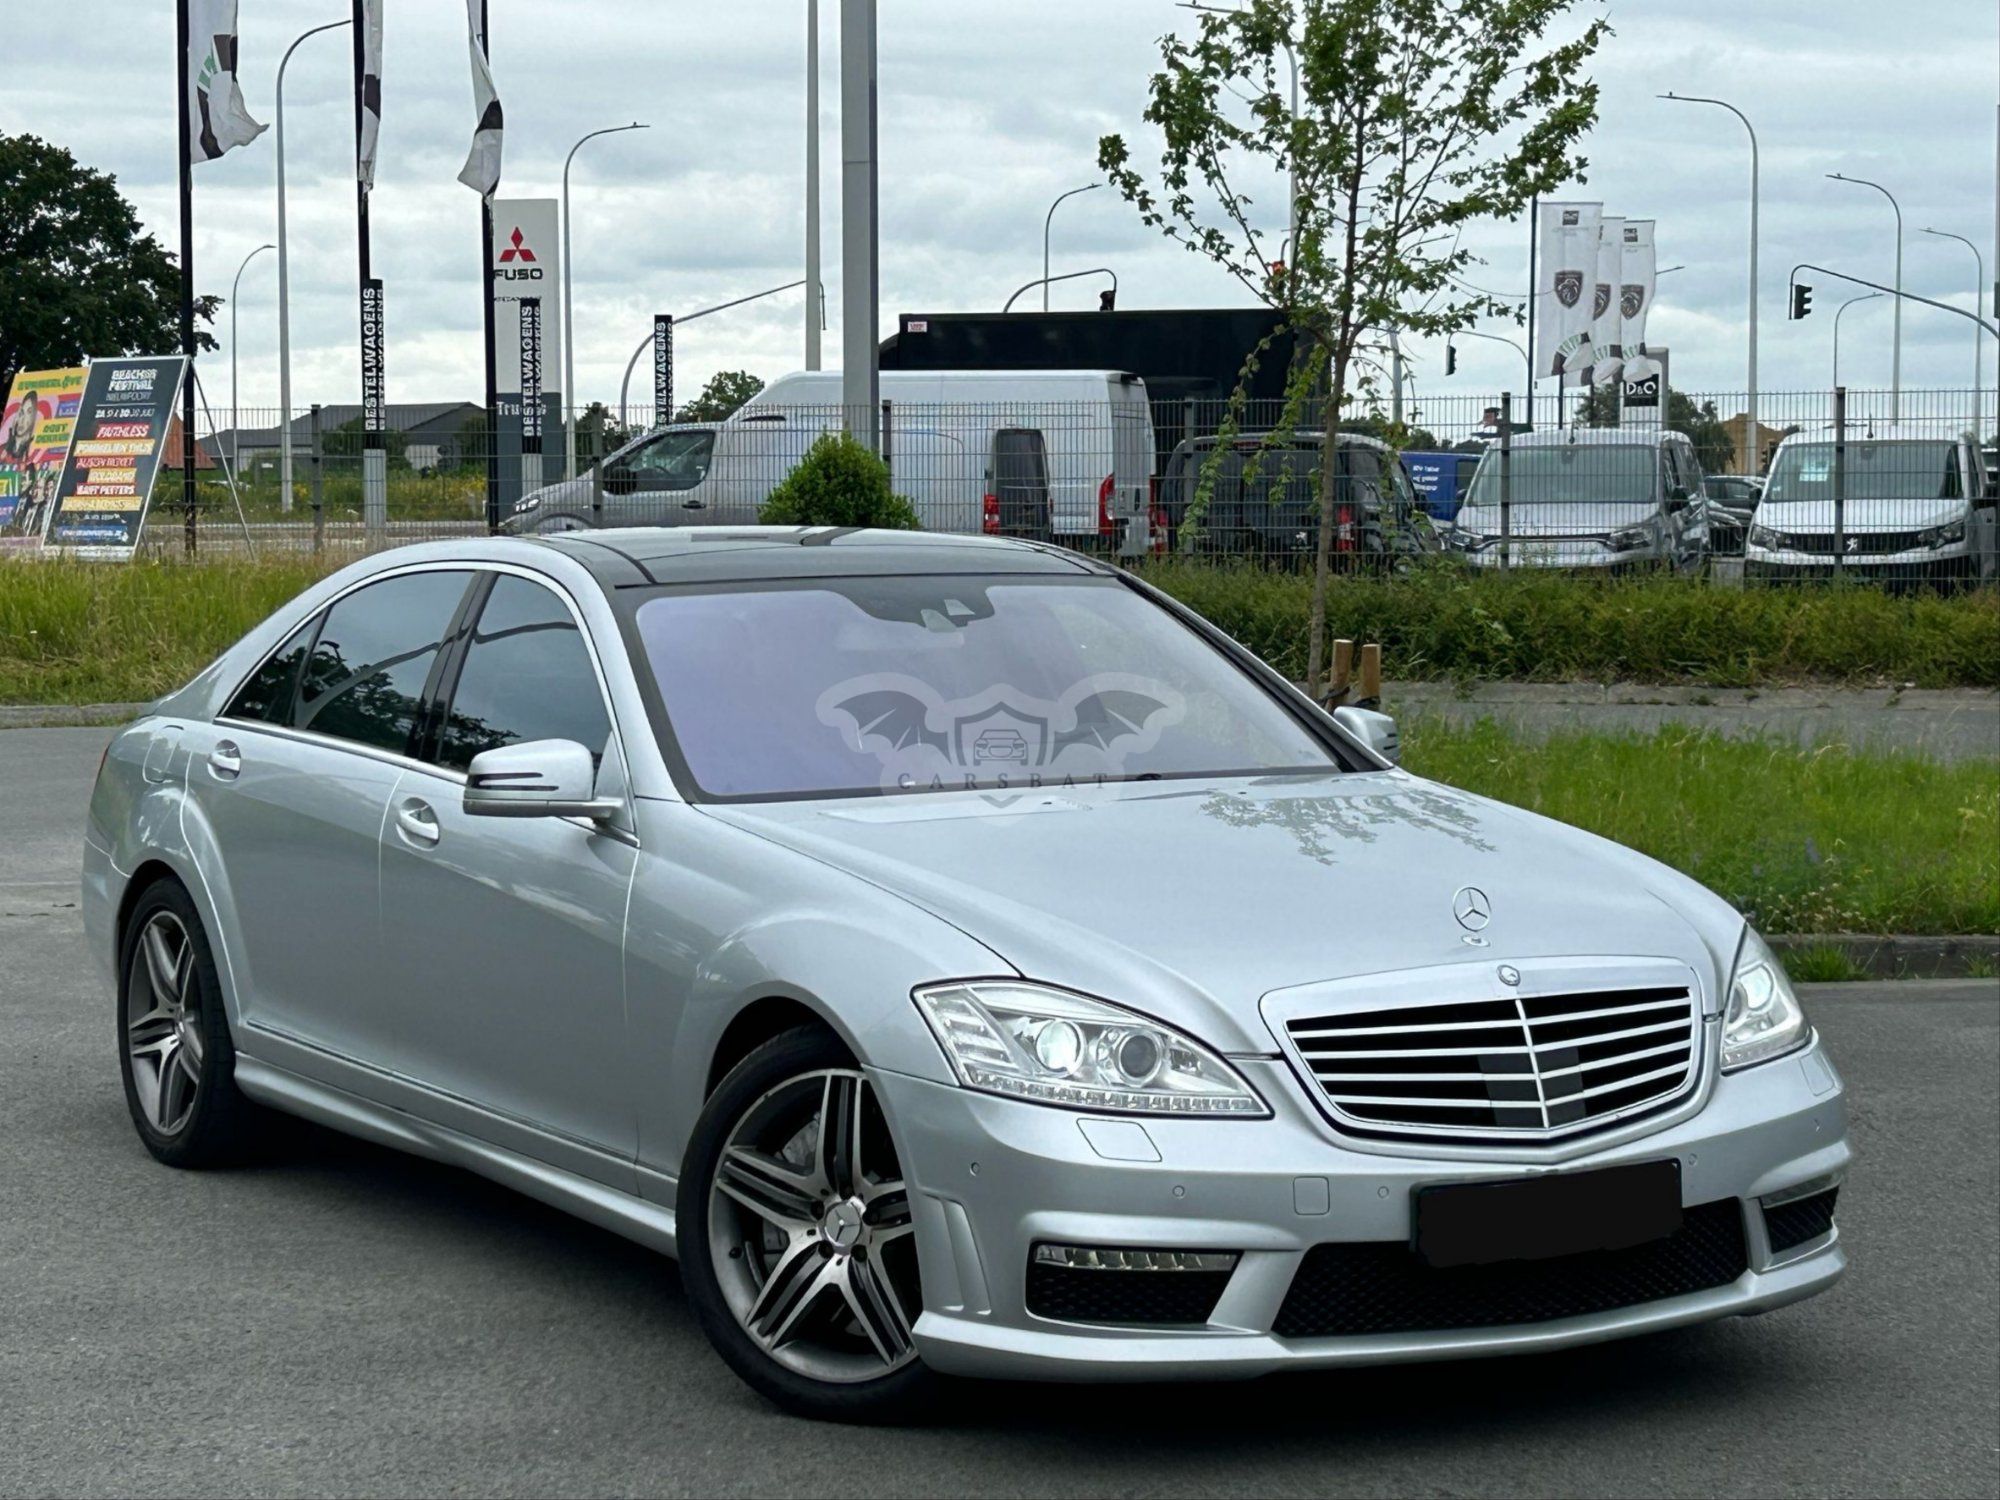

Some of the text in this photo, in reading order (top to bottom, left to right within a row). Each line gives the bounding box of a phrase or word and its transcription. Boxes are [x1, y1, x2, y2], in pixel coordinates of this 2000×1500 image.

[494, 269, 543, 280] FUSO
[363, 288, 377, 430] BESTELWAGENS
[522, 306, 534, 437] BESTELWAGENS
[497, 402, 546, 416] Trus
